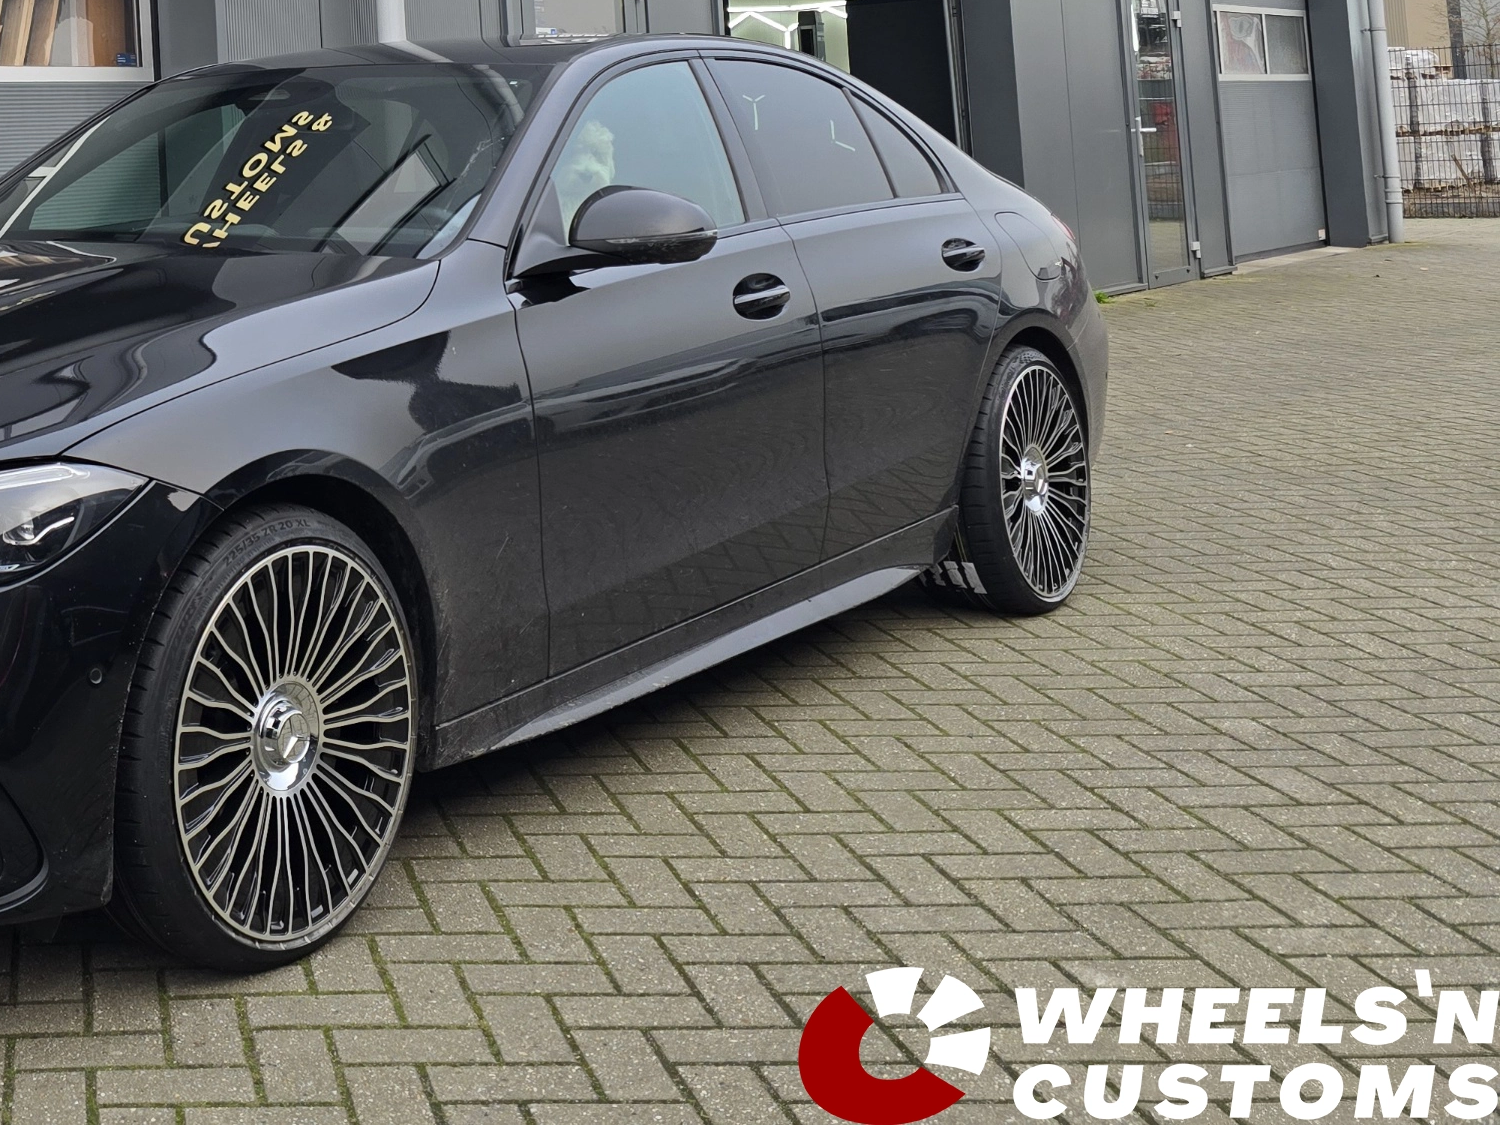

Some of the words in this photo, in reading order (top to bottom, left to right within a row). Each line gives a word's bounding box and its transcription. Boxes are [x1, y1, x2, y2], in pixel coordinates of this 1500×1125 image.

[223, 533, 261, 566] 225/35
[261, 525, 277, 537] ZR
[278, 519, 293, 530] 20
[296, 519, 310, 528] XL
